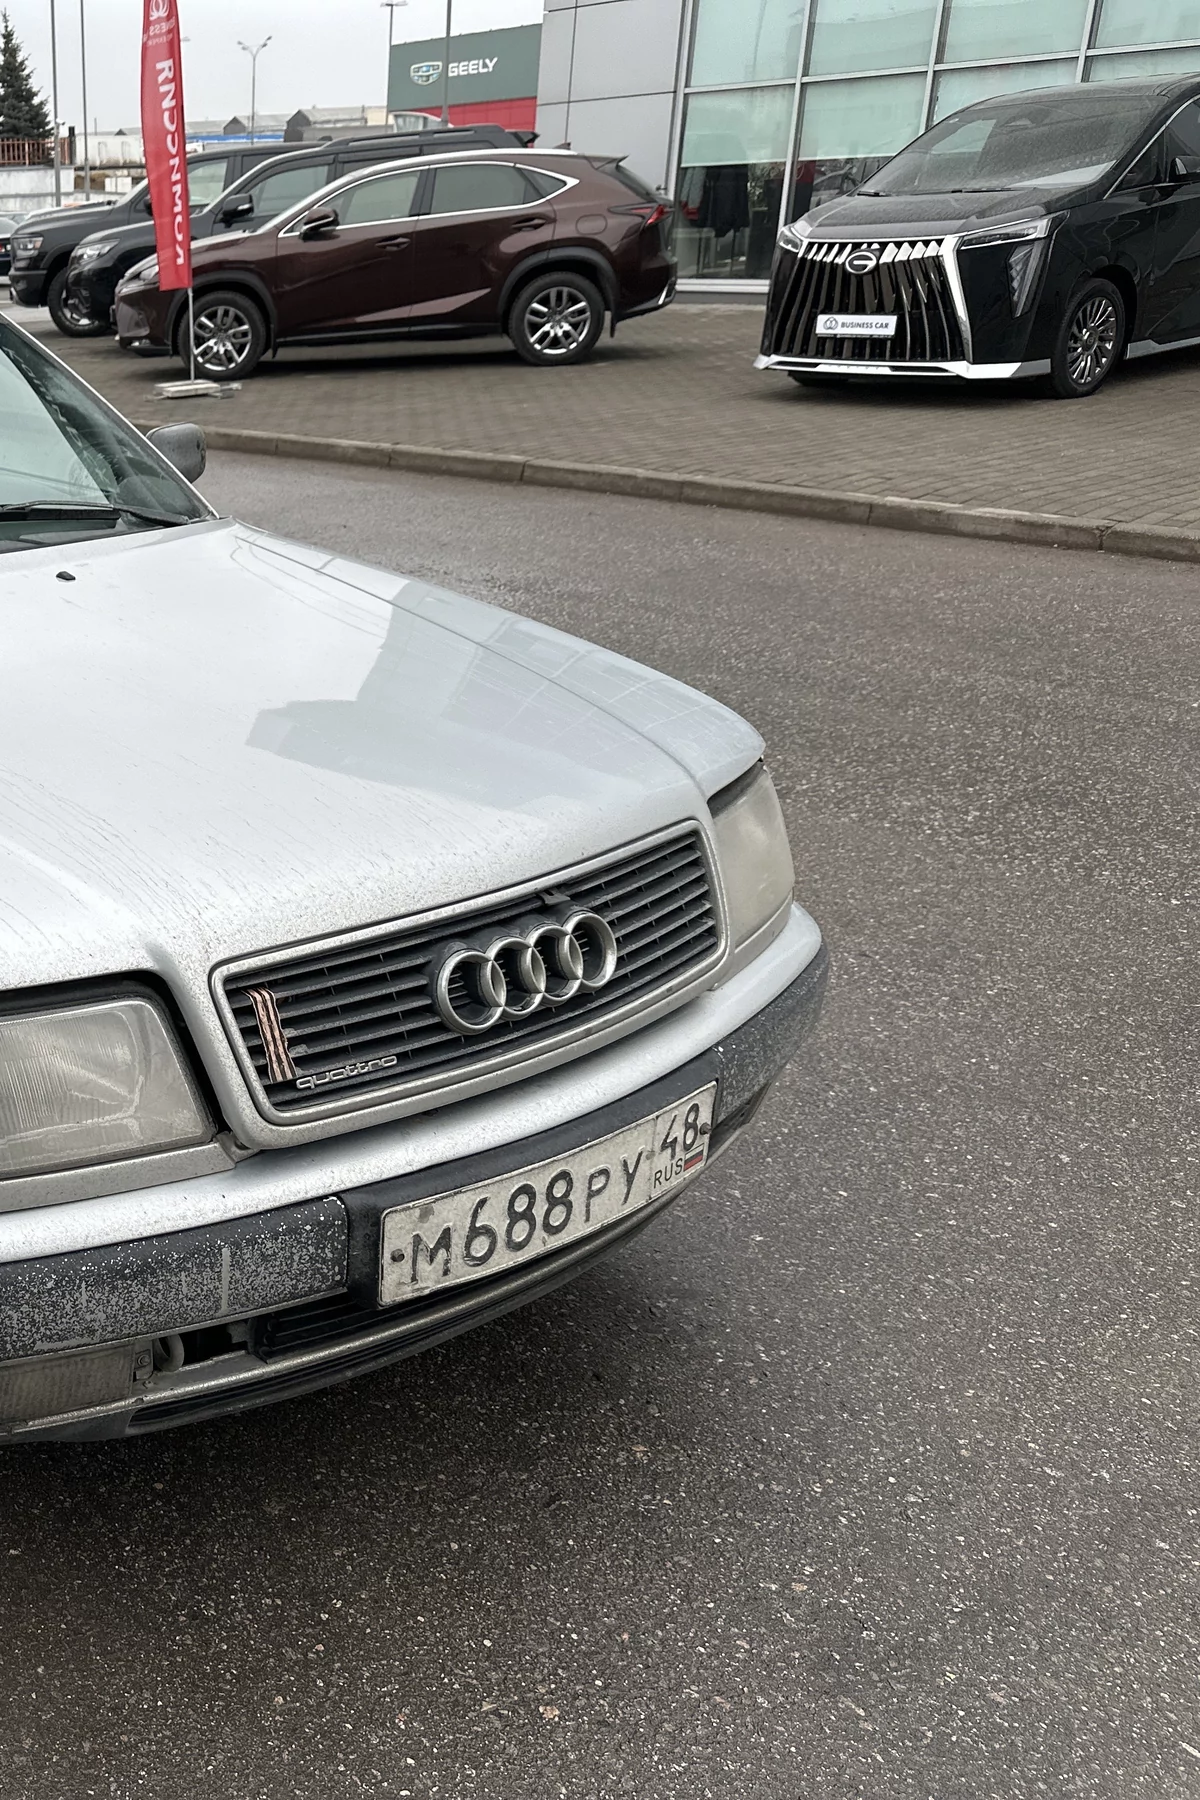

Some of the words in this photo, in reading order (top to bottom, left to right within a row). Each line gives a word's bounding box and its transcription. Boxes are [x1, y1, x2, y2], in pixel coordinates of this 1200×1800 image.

[448, 57, 498, 78] GEELY
[840, 321, 873, 329] BUSINESS
[295, 1055, 398, 1090] quattro
[653, 1158, 683, 1189] RUS
[409, 1148, 645, 1285] М688РУ
[660, 1103, 700, 1160] 48
